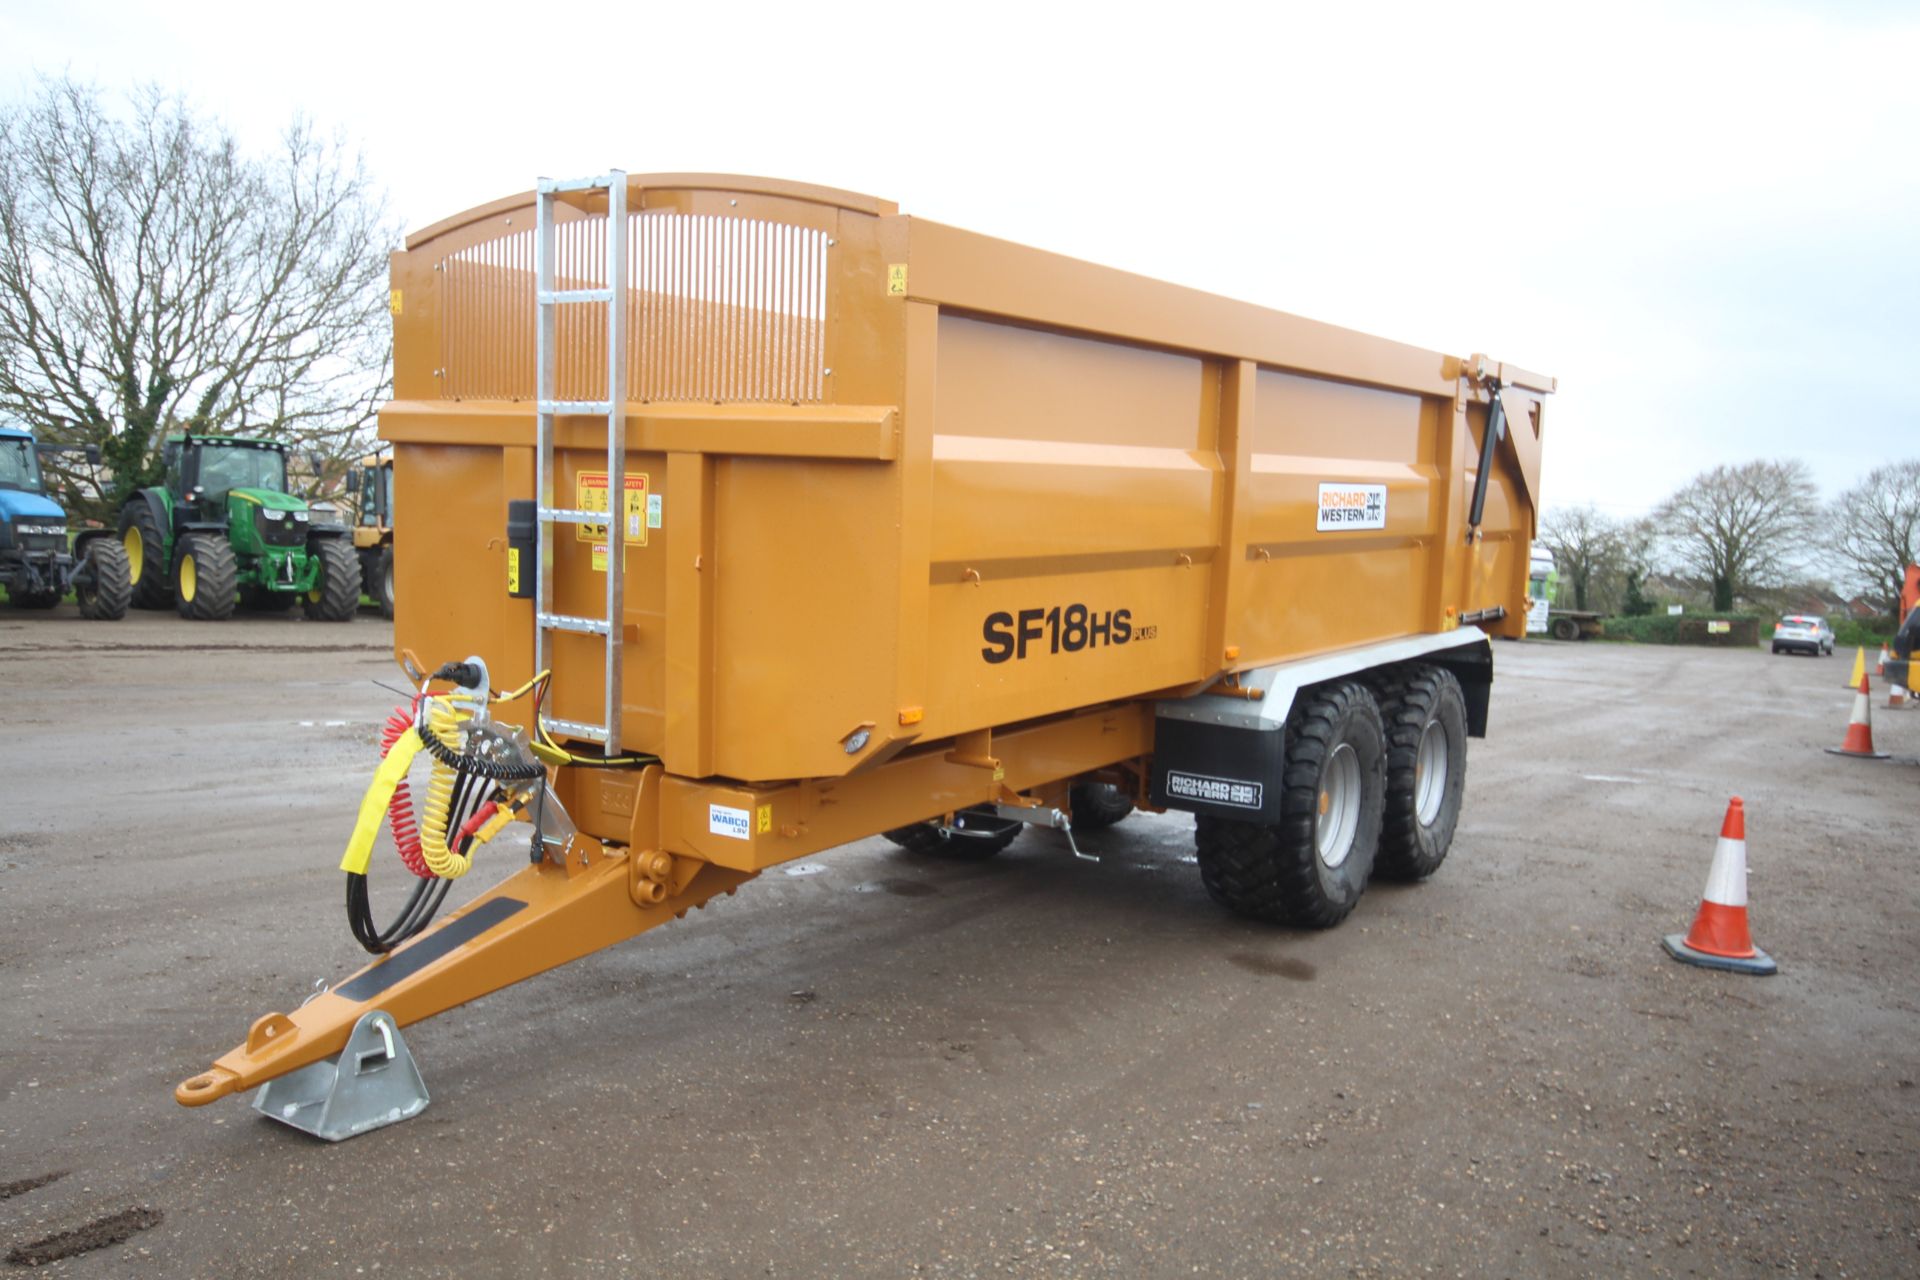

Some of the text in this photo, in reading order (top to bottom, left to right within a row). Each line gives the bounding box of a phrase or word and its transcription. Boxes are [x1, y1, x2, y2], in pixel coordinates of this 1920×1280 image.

[1322, 492, 1366, 507] RICHARD
[1321, 508, 1365, 522] WESTERN
[1132, 625, 1157, 641] PLUS
[1172, 775, 1230, 793] RICHARD
[1172, 782, 1229, 801] WESTERN
[712, 813, 748, 828] WABCO
